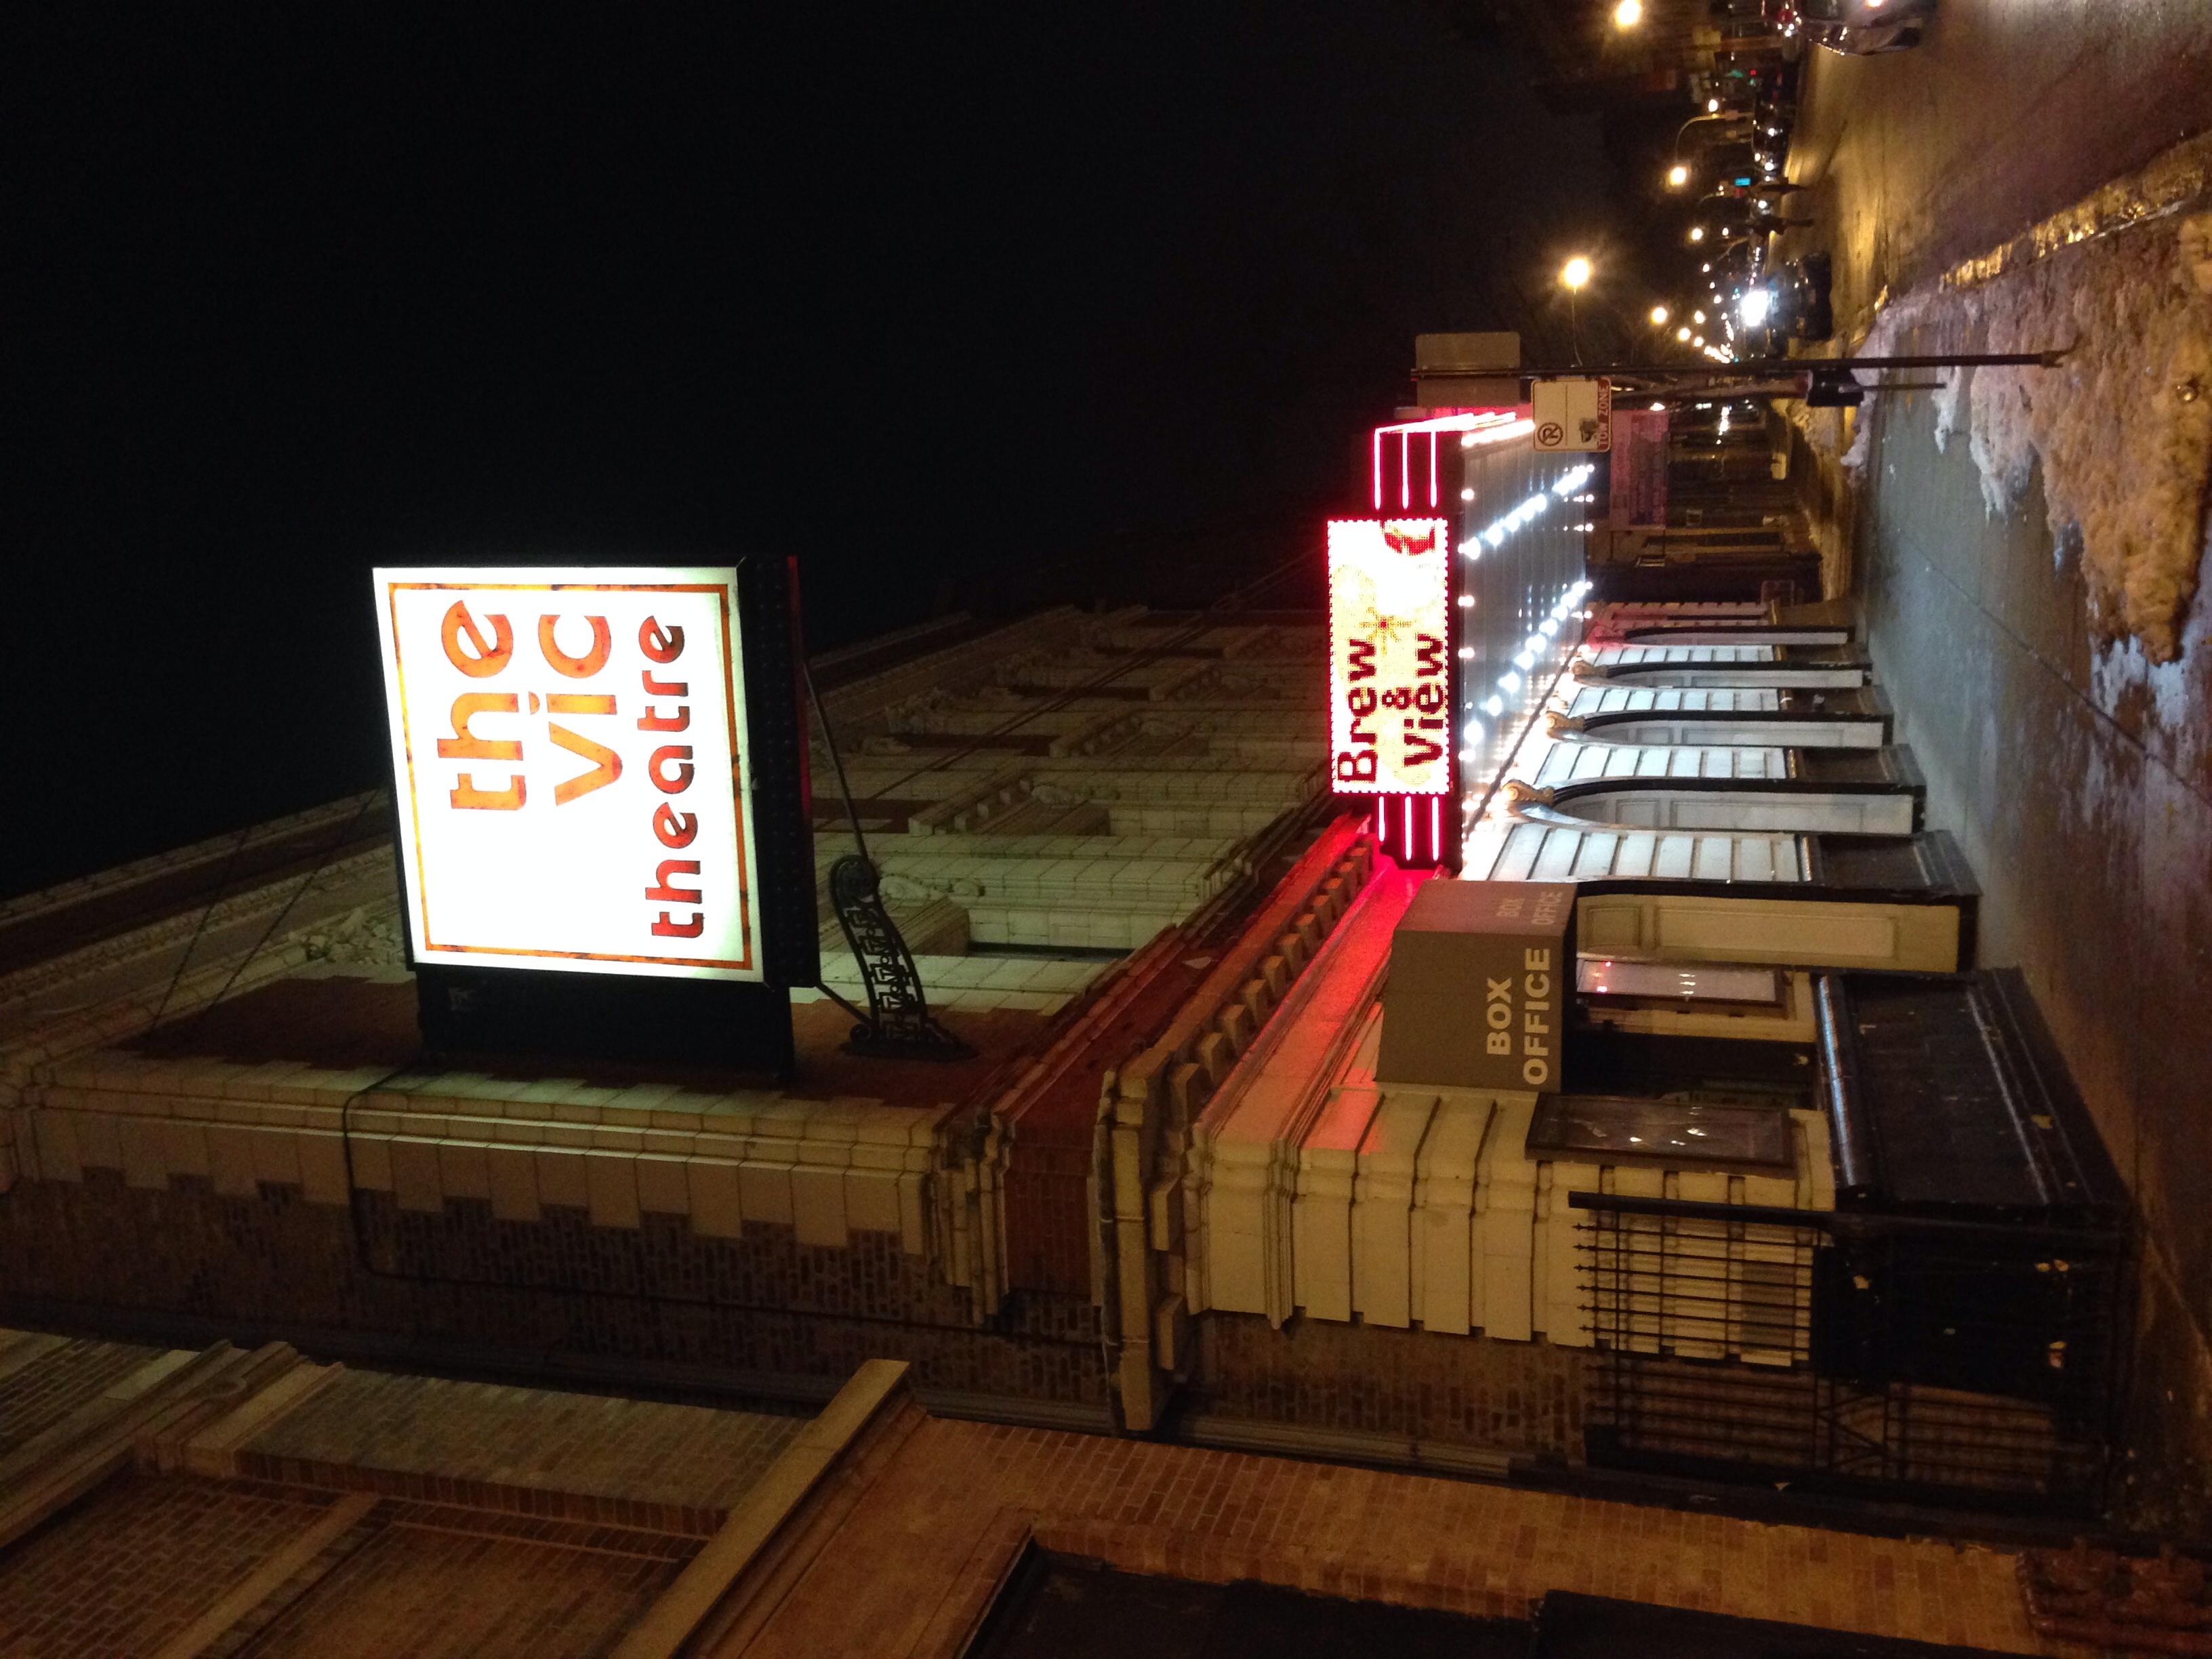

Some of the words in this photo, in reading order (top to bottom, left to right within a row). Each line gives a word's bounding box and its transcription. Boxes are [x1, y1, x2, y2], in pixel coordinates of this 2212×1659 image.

[1599, 385, 1608, 416] ZONE
[1599, 422, 1608, 445] TOW
[437, 600, 527, 811] the
[528, 615, 622, 806] vic
[1337, 639, 1377, 783] Brew
[1381, 688, 1411, 710] &
[1404, 634, 1443, 766] View
[637, 615, 703, 939] theatre
[1496, 899, 1524, 917] BOX
[1532, 892, 1562, 925] OFFICE
[1486, 977, 1512, 1056] BOX
[1522, 948, 1550, 1084] OFFICE
